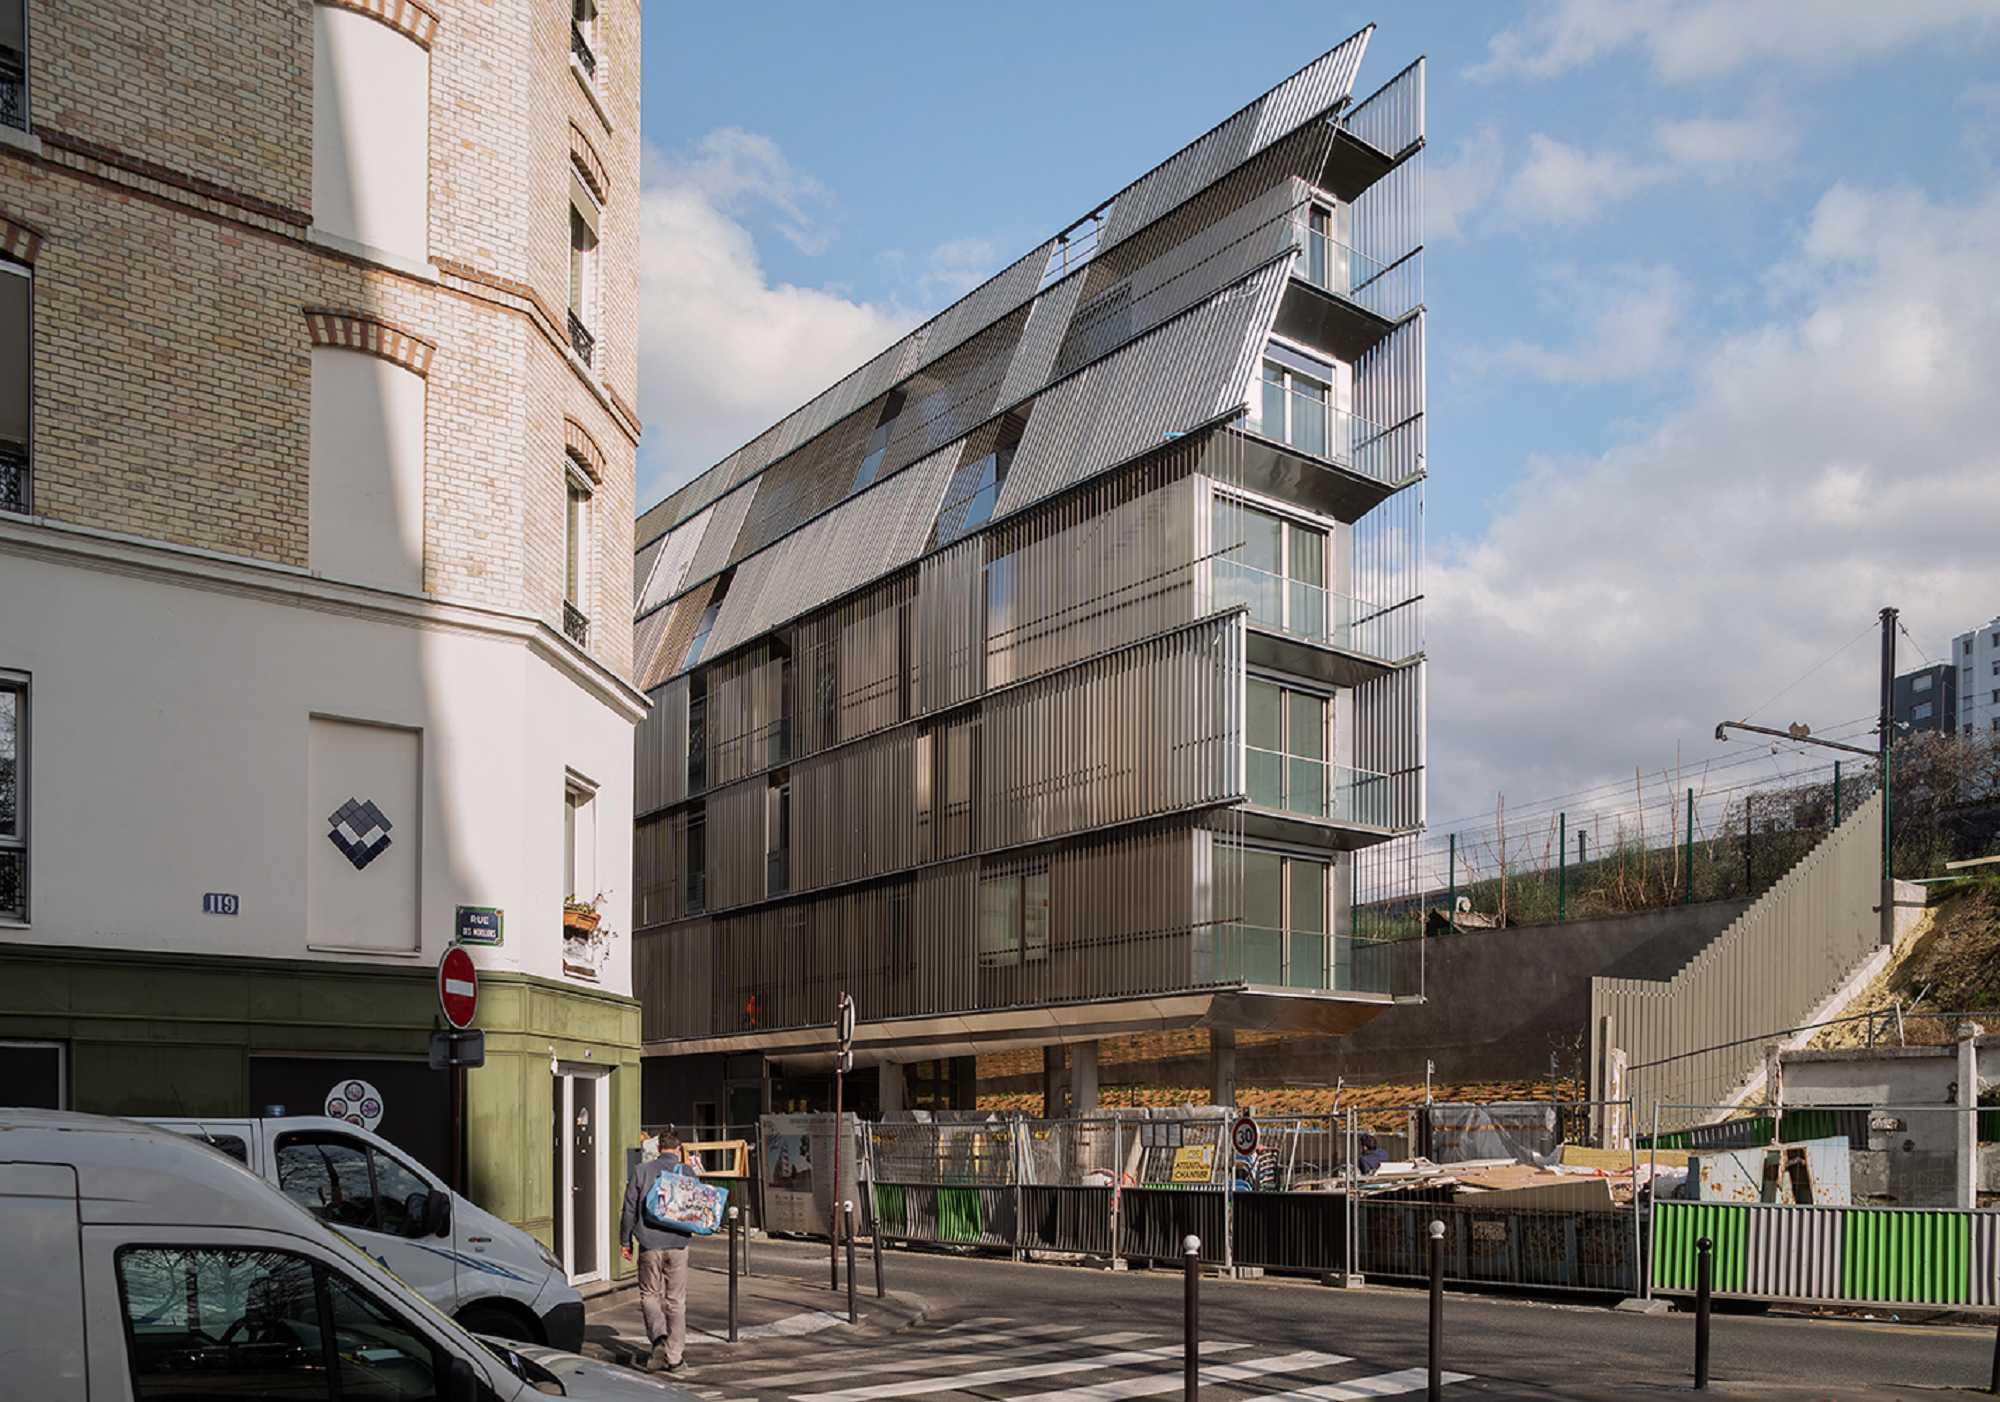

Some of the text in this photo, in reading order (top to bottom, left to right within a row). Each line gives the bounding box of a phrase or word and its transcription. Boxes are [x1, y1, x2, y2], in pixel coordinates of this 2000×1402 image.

[209, 895, 236, 914] 119
[470, 914, 489, 925] RUE
[1238, 1128, 1253, 1145] 30
